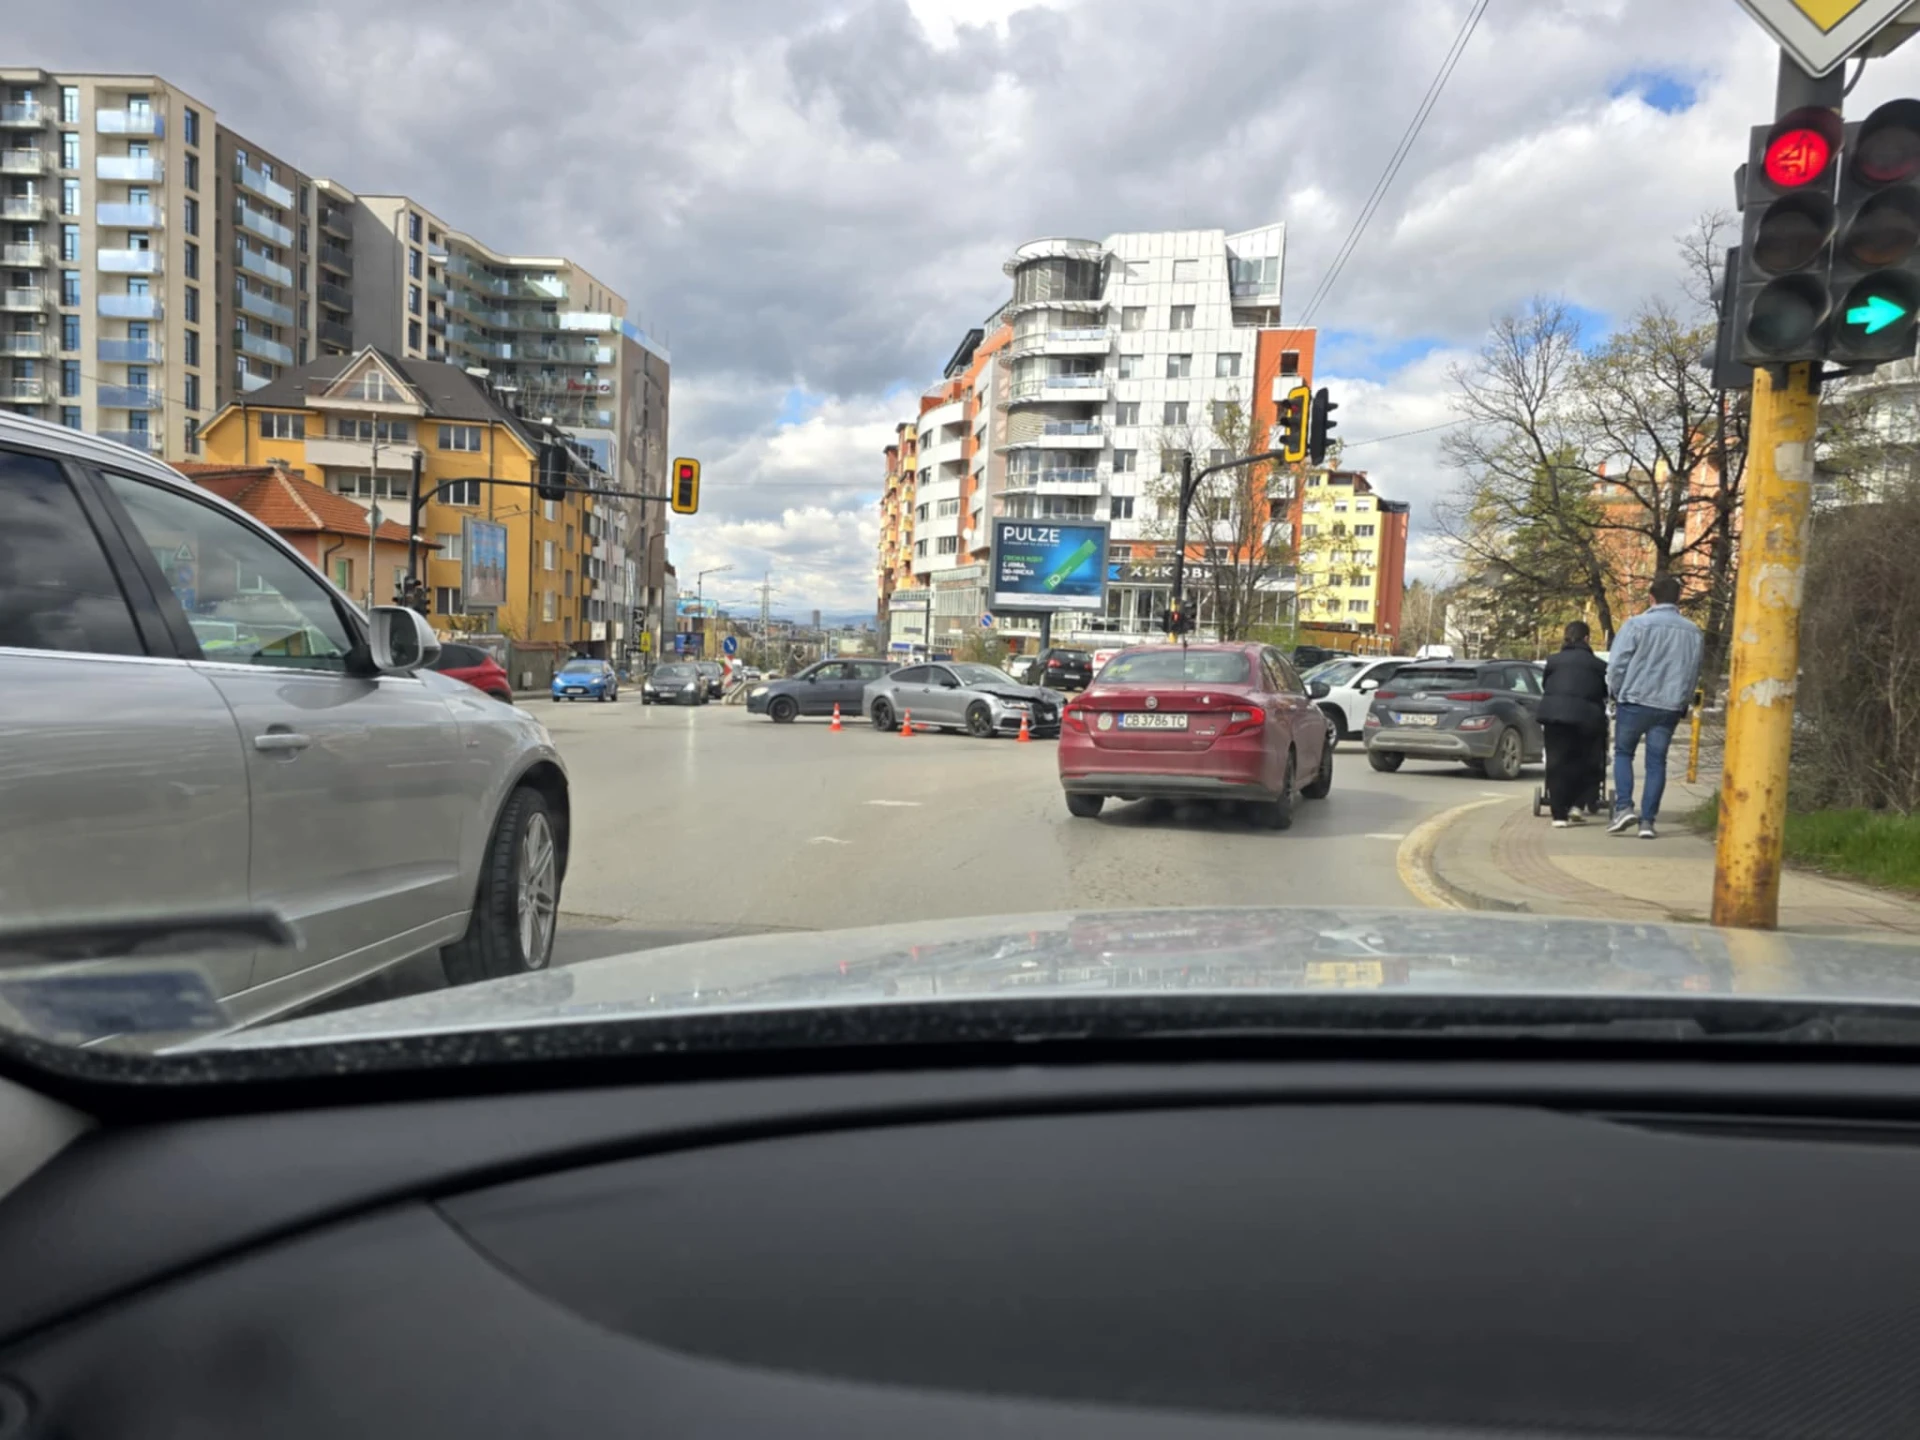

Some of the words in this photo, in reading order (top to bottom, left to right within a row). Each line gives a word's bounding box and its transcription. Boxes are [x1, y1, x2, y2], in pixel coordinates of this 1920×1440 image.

[1003, 526, 1060, 543] PULZE
[1125, 714, 1139, 726] CB
[1140, 714, 1169, 726] 3786
[1170, 715, 1186, 727] TC
